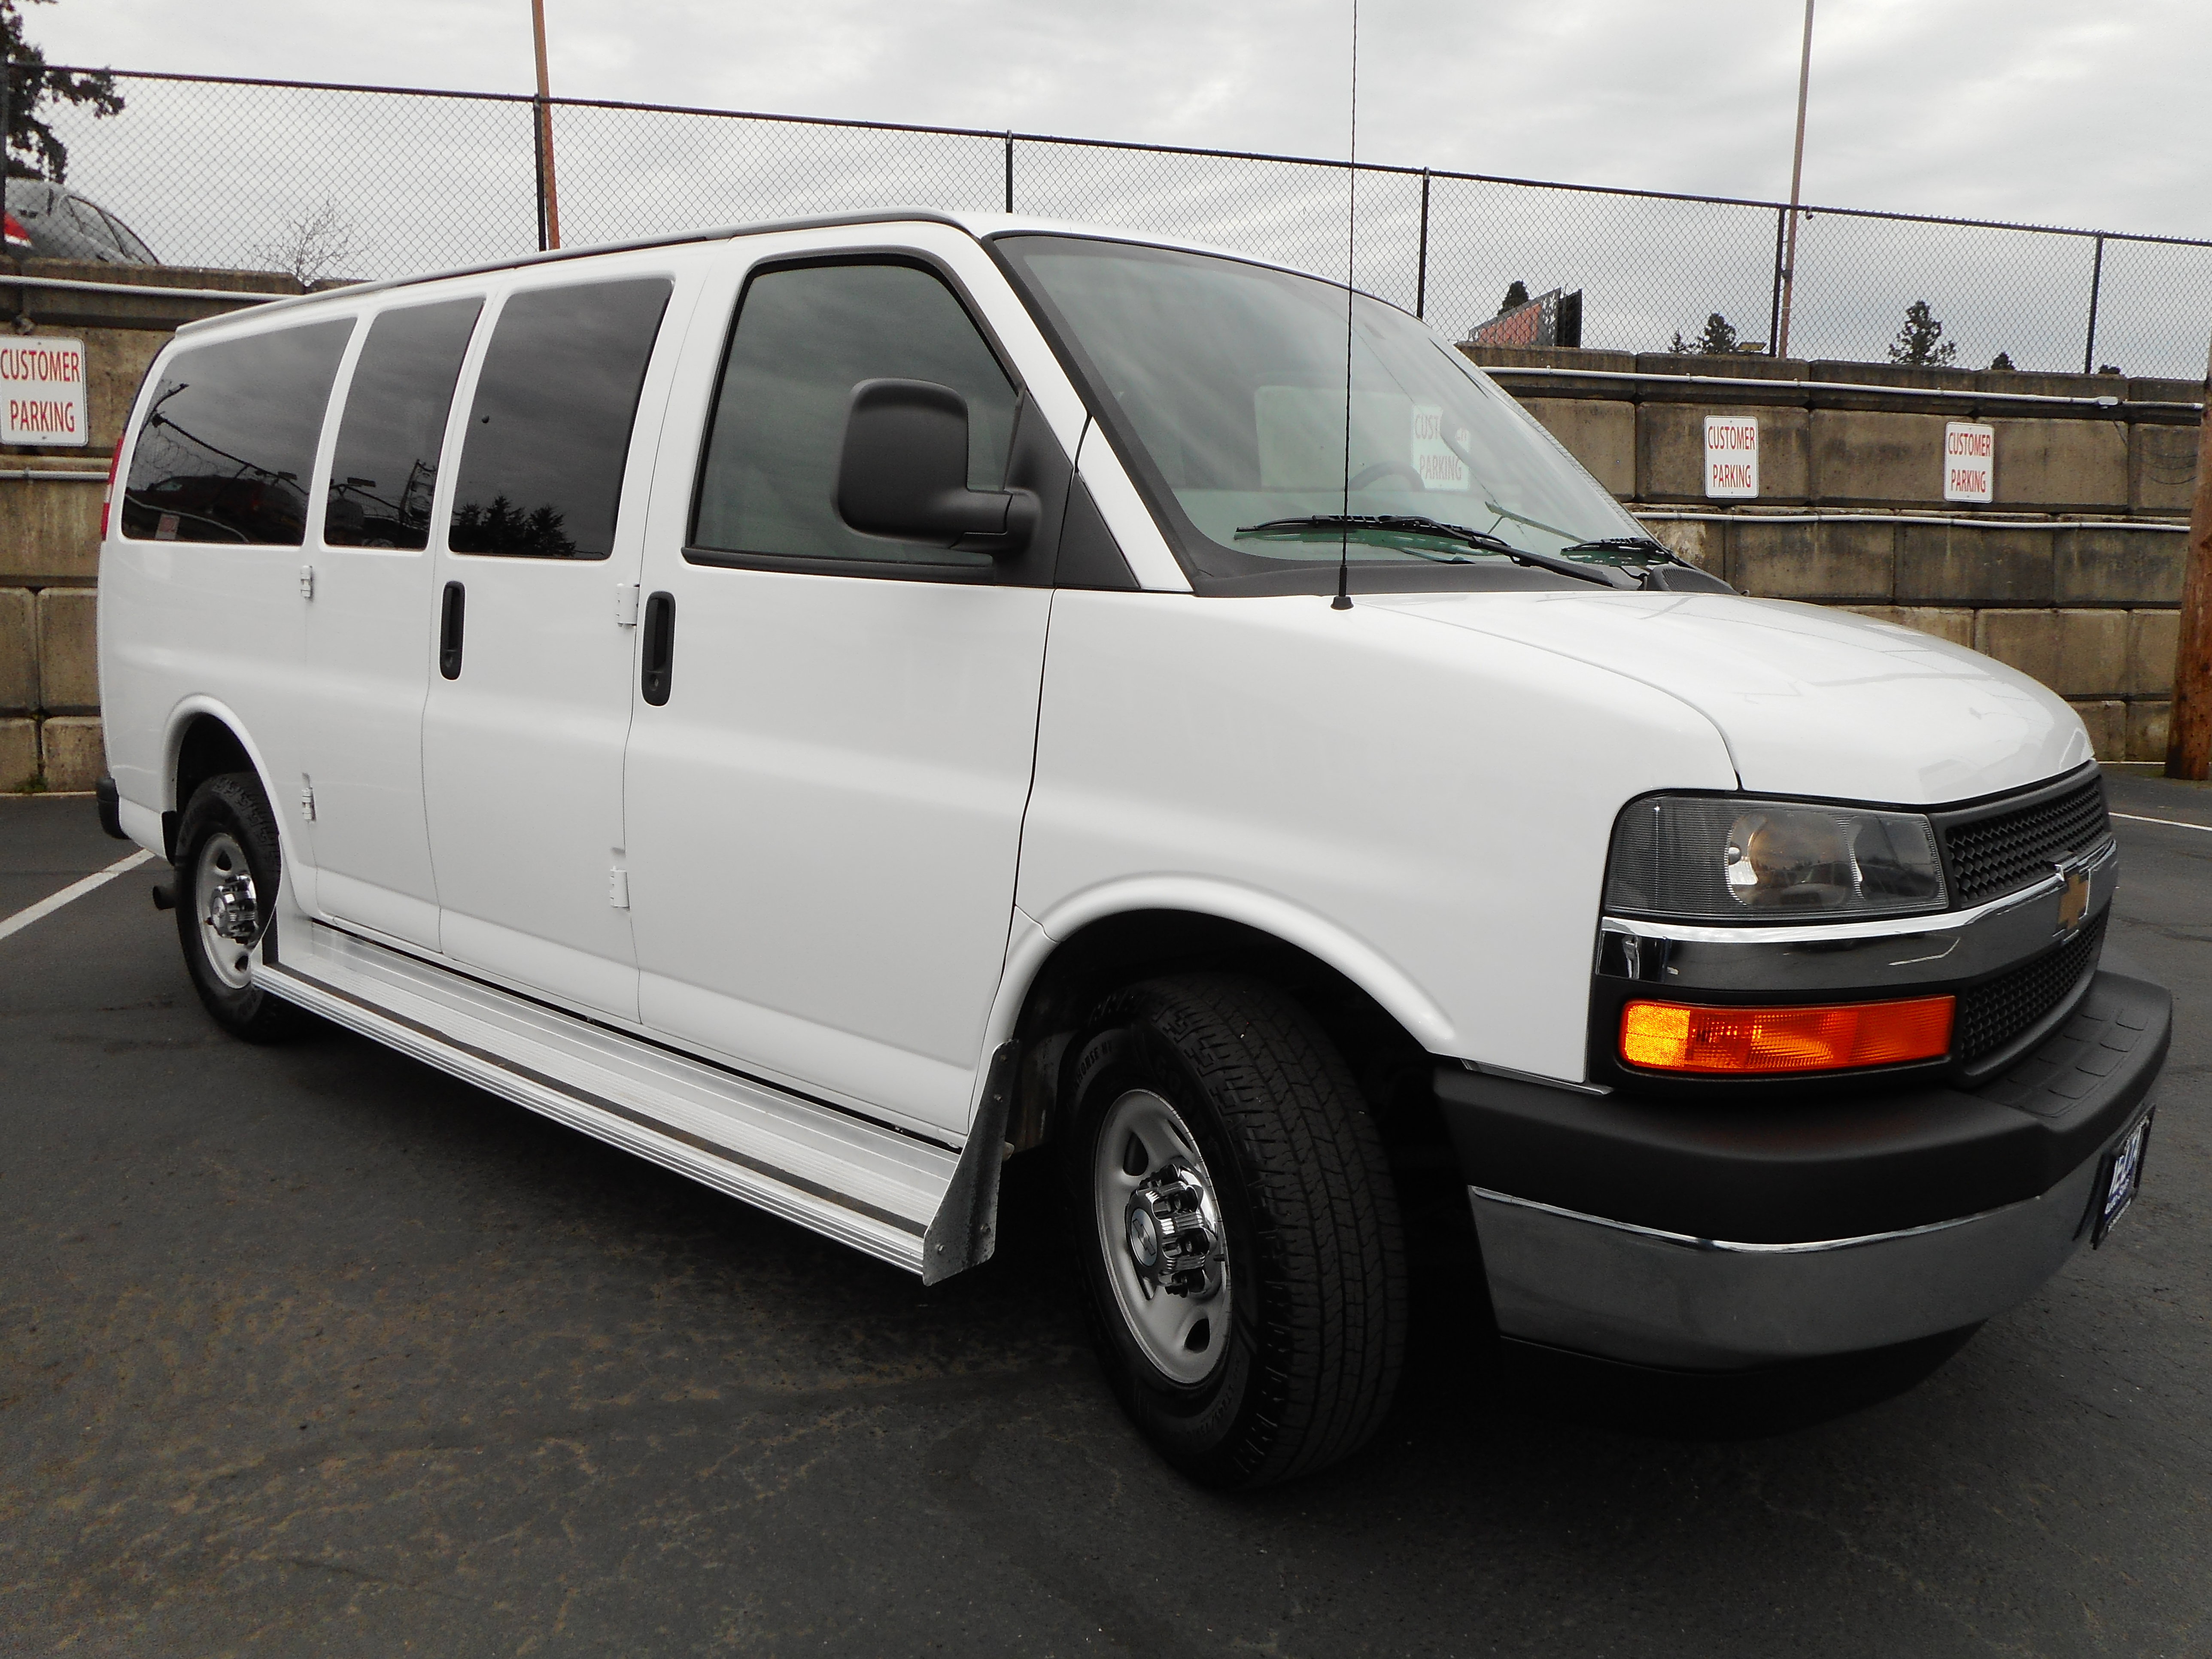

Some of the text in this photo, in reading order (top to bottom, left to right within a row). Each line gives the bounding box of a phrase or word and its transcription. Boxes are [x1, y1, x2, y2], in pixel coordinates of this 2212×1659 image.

[0, 348, 80, 382] CUSTOMER
[10, 399, 75, 432] PARKING
[1708, 425, 1755, 450] CUSTOMER
[1948, 432, 1991, 457] CUSTOMER
[1420, 455, 1462, 480] PARKING
[1713, 464, 1751, 488] PARKING
[1951, 469, 1986, 493] PARKING
